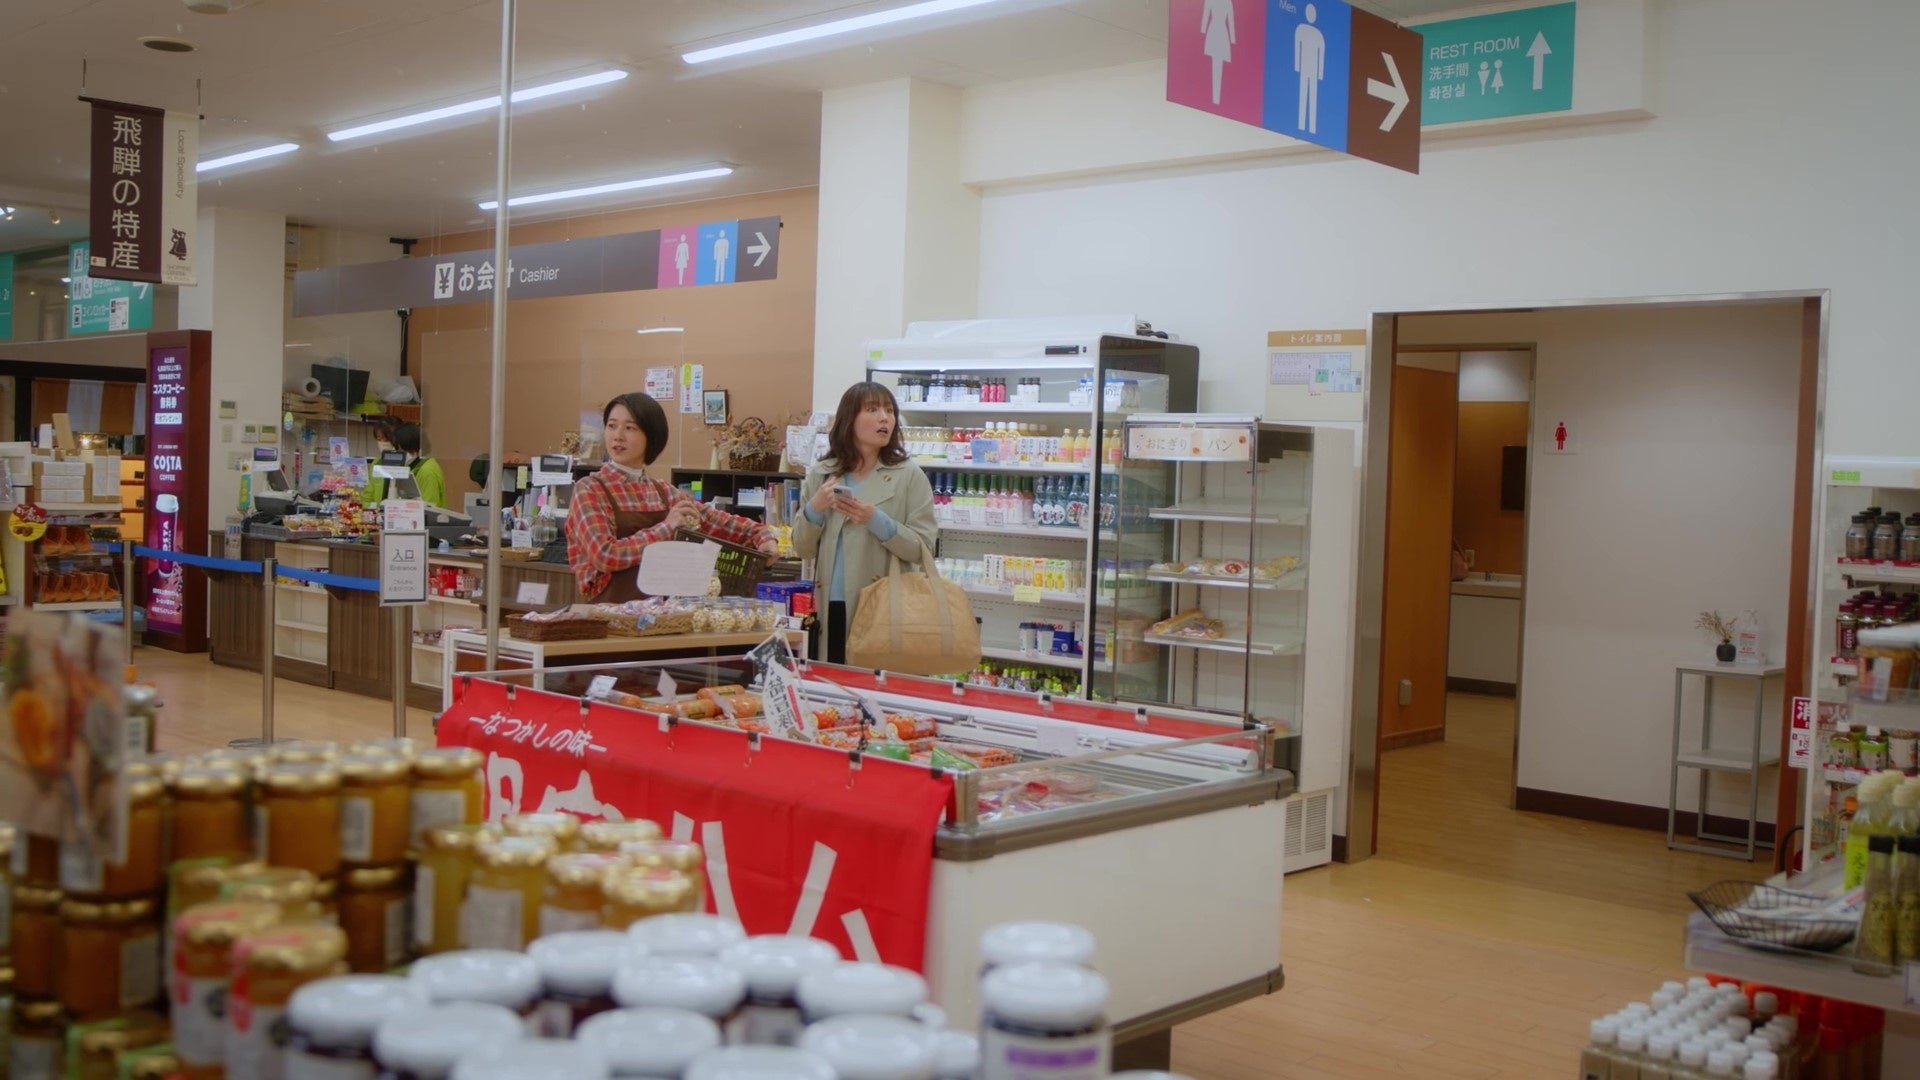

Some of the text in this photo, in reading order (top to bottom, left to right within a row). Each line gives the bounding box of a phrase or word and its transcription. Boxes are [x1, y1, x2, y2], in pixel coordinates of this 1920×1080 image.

[1430, 36, 1520, 60] REST ROOM
[1429, 62, 1469, 80] 洗手間
[1428, 82, 1466, 100] 화장실
[177, 129, 186, 155] Local
[111, 114, 142, 270] 飛騨の特産
[519, 265, 560, 283] Cashier
[1145, 438, 1187, 450] おにぎり
[153, 455, 182, 472] COSTA
[393, 549, 414, 561] 入口
